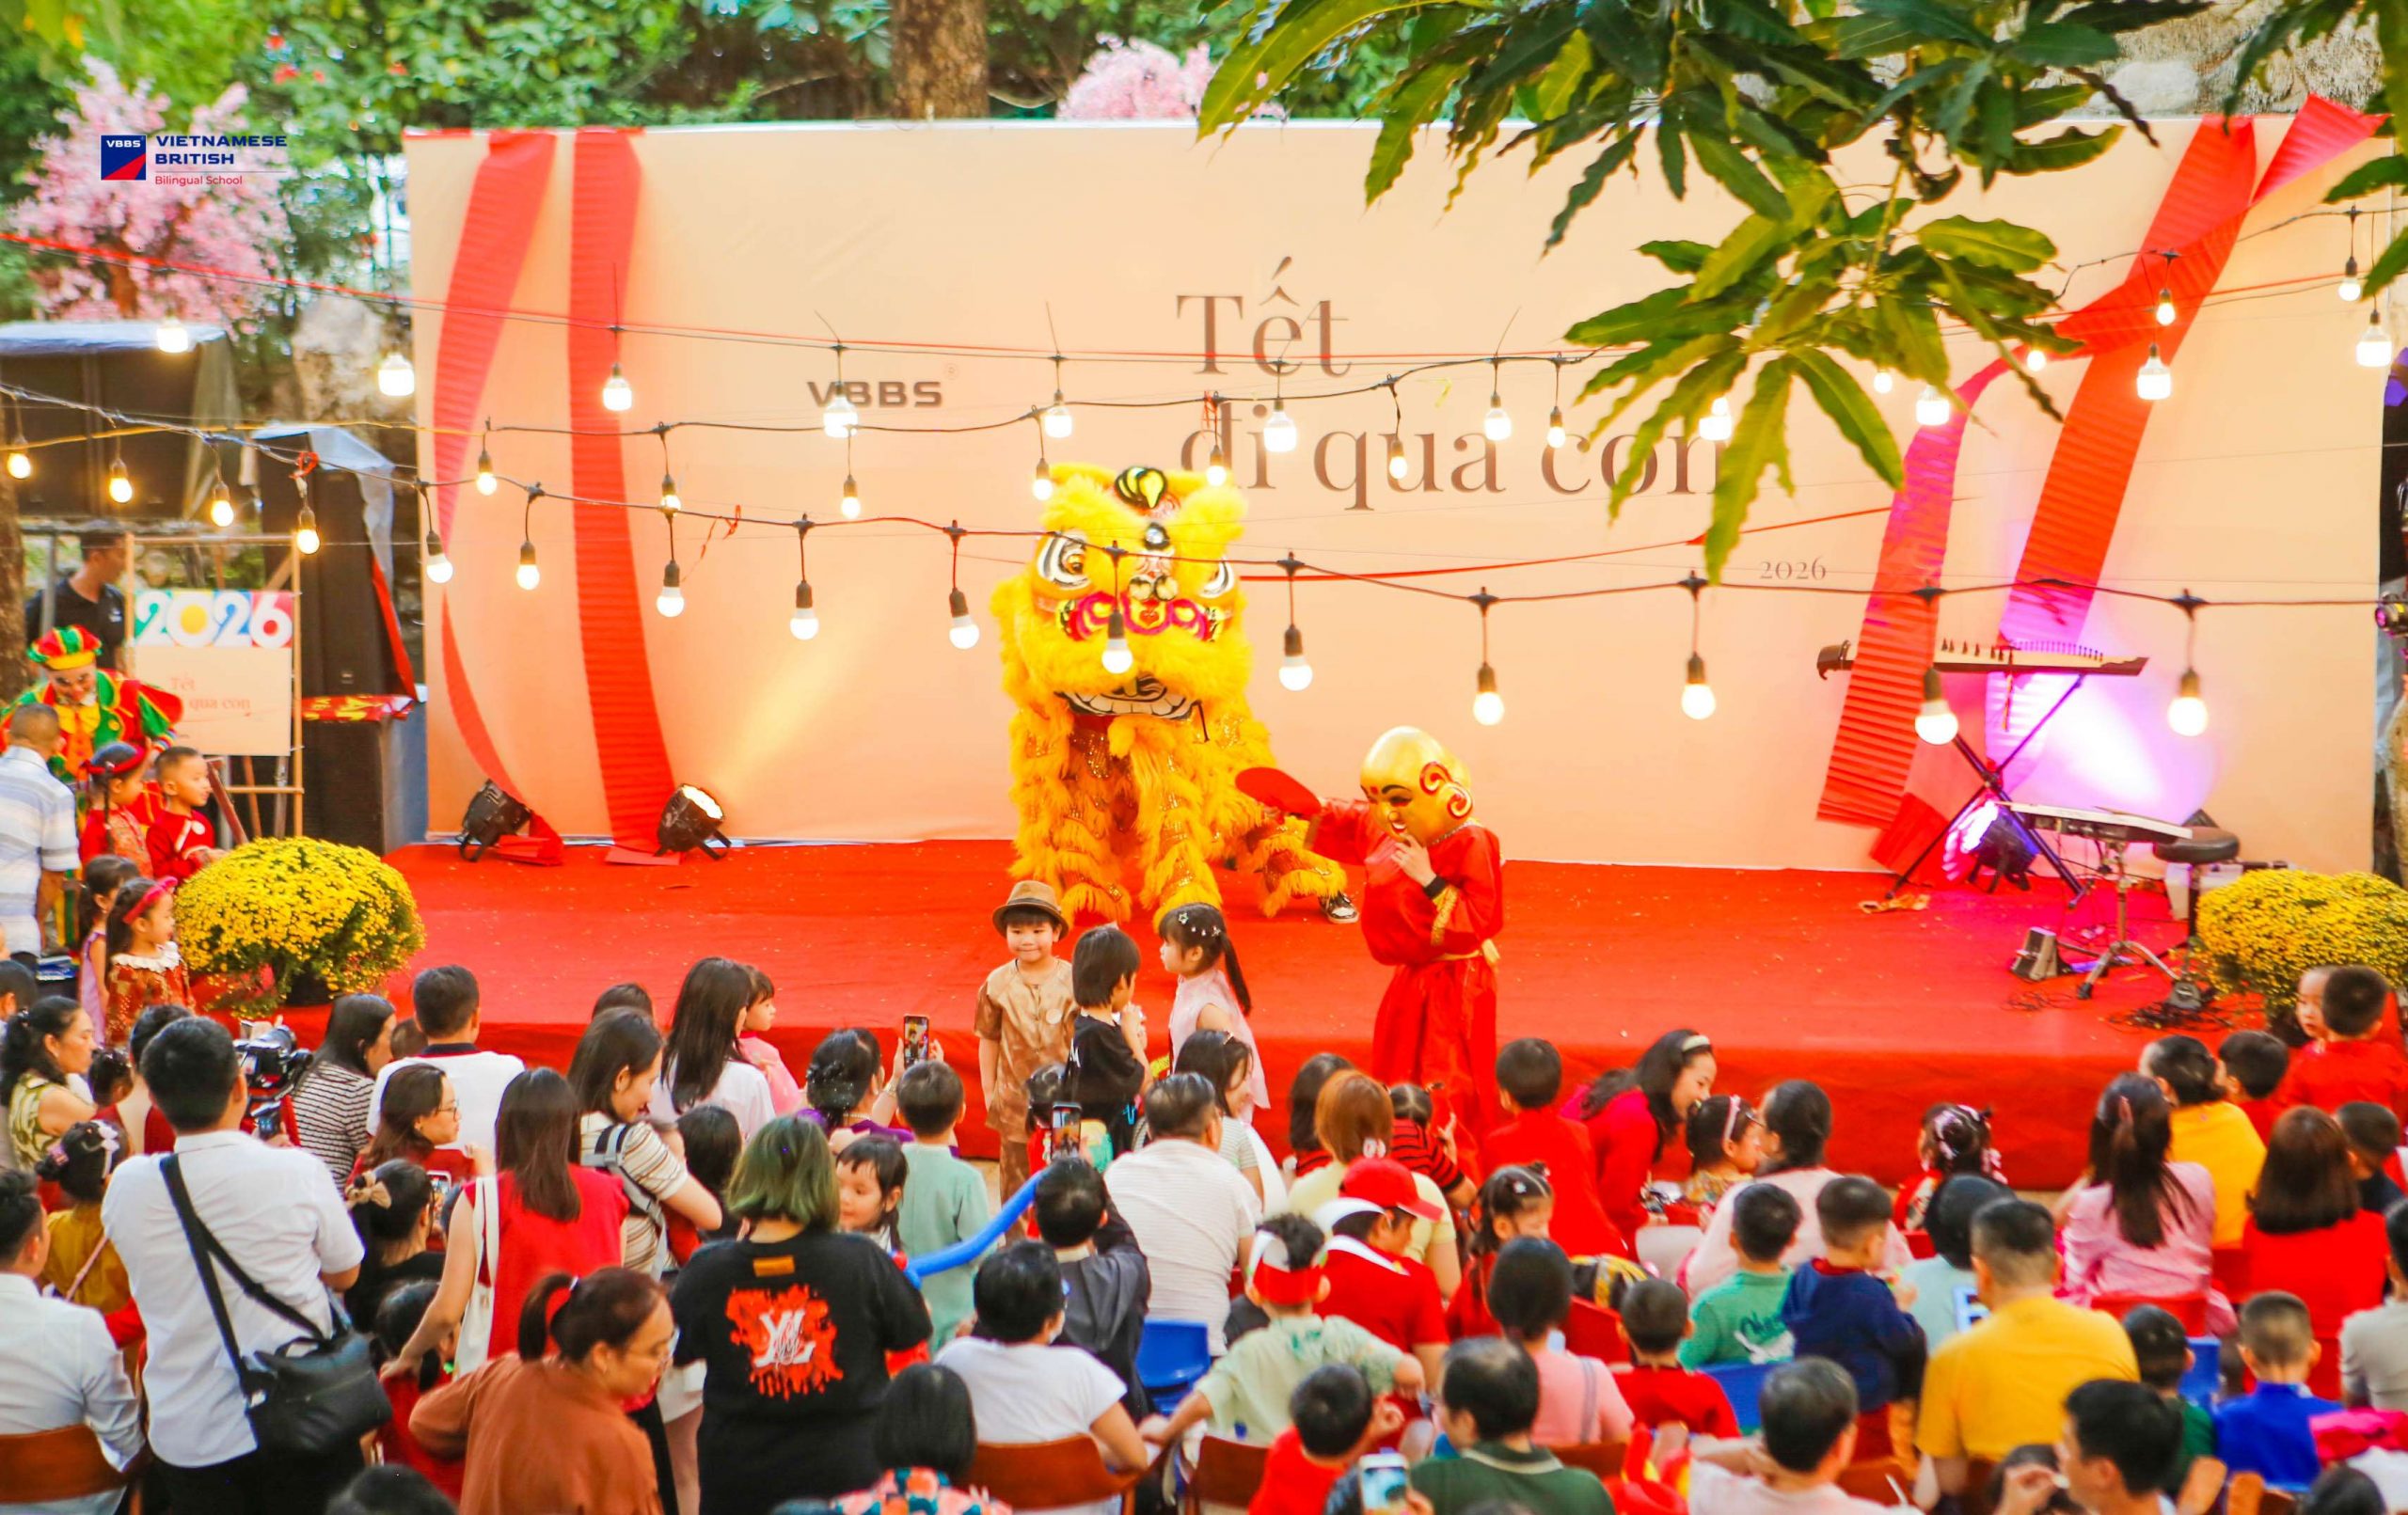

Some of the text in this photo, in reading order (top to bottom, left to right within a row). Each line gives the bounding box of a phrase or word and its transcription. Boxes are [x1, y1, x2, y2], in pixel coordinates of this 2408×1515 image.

[1177, 256, 1351, 377] Tết
[807, 381, 943, 407] VBBS
[1314, 432, 1507, 511] qua
[1542, 434, 1729, 495] con
[1760, 556, 1827, 580] 2026
[135, 591, 293, 648] 2026
